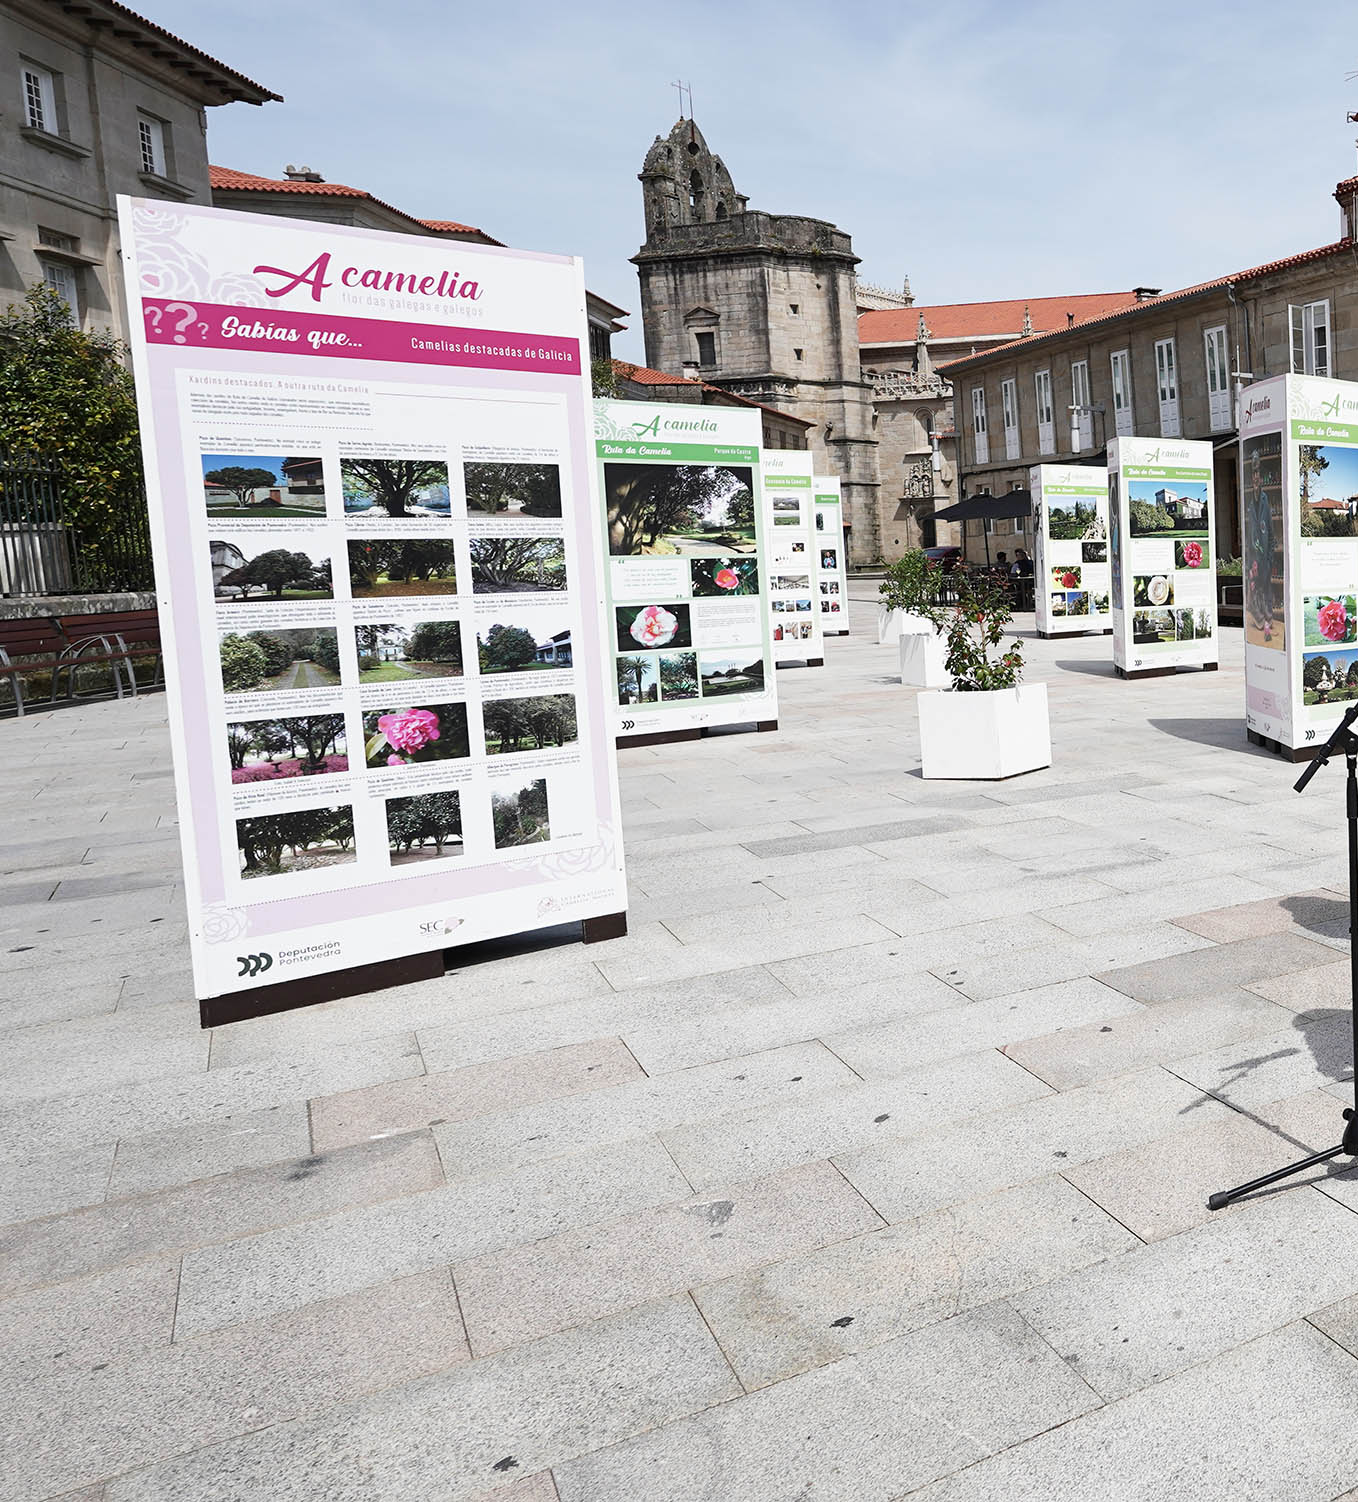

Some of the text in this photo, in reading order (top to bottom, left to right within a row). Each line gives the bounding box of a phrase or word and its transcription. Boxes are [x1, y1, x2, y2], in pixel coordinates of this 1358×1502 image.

[253, 252, 484, 302] A camelia
[342, 293, 484, 318] flor das galegas e galegos
[221, 315, 573, 362] Sabías que... Camelias destacadas de Galicia
[284, 381, 306, 391] outra
[308, 383, 325, 392] ruta
[326, 383, 336, 393] da
[337, 384, 369, 394] Camelia
[1321, 393, 1341, 416] A
[632, 415, 719, 437] A camelia
[601, 444, 672, 456] Ruta da Camelia
[1144, 447, 1160, 463] A
[419, 919, 444, 935] SEC
[278, 940, 341, 959] Deputación
[279, 948, 341, 966] Pontevedra
